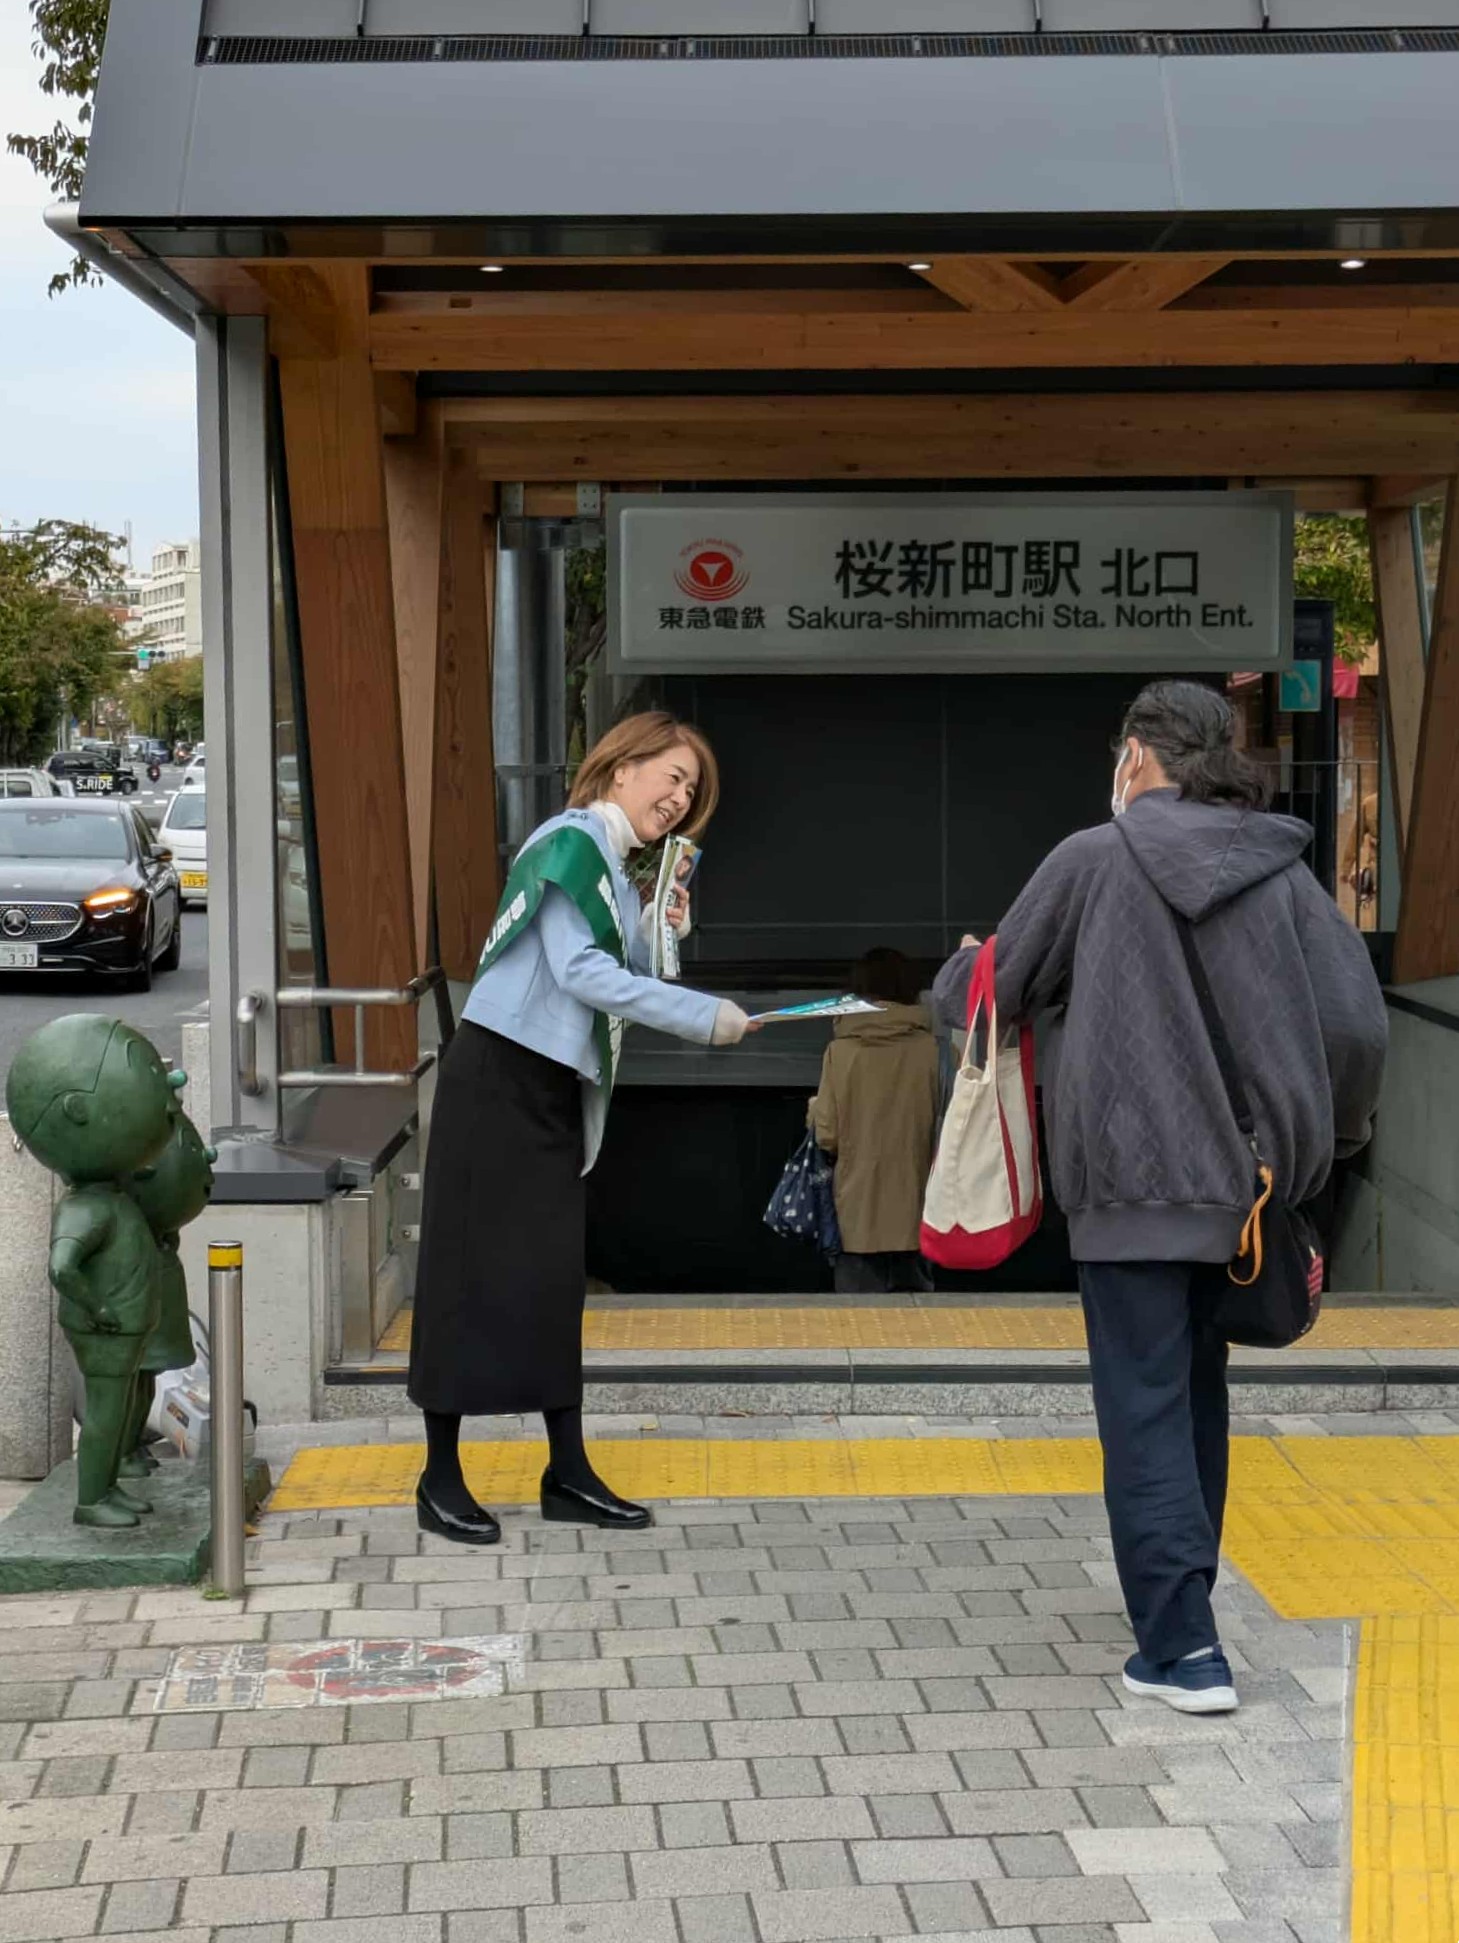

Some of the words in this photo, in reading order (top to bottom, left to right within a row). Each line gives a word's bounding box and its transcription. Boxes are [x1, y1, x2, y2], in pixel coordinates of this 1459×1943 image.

[835, 539, 1081, 599] 桜新町駅
[1100, 547, 1199, 598] 北口
[658, 607, 767, 629] 東急電鉄
[787, 604, 1045, 629] Sakura-shimmachi
[1053, 603, 1106, 629] Sta.
[1115, 604, 1192, 628] North
[1202, 603, 1254, 628] Ent.
[76, 775, 114, 790] S.RIDE
